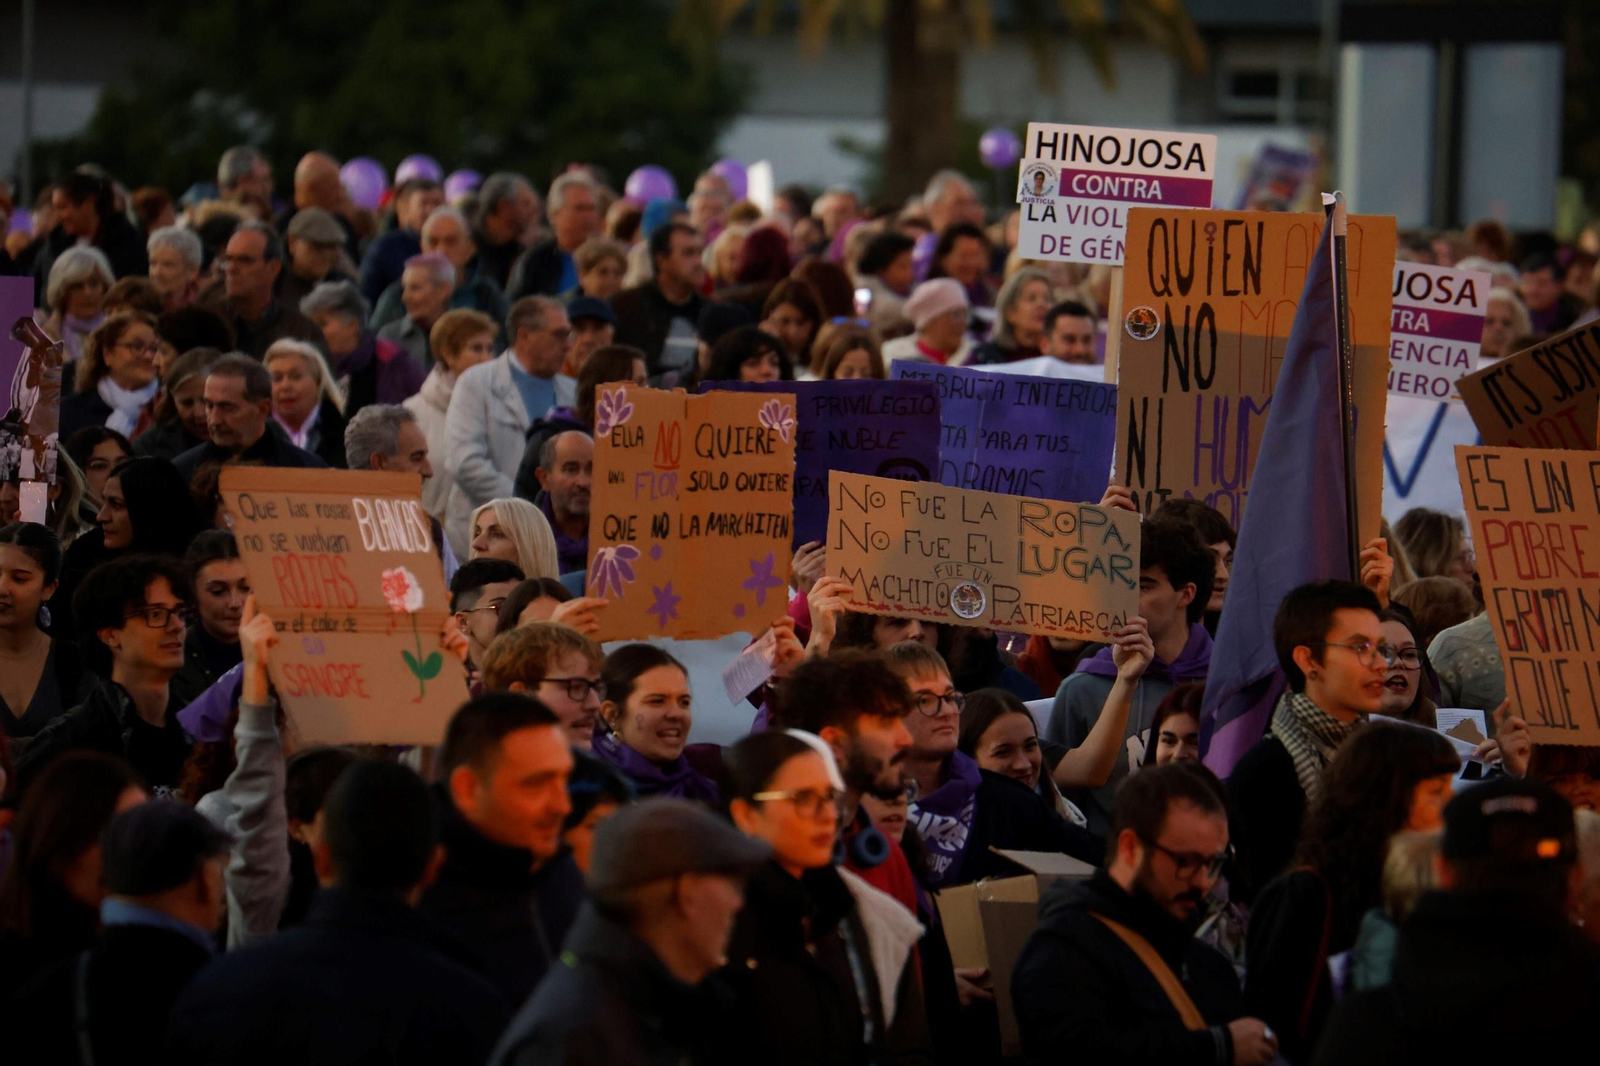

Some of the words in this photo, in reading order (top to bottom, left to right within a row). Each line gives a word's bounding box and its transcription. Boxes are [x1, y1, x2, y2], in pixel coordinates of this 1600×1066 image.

[1036, 130, 1206, 172] HINOJOSA
[1021, 196, 1055, 205] JUSTICIA
[1071, 173, 1163, 201] CONTRA
[1028, 204, 1057, 223] LA
[1066, 204, 1123, 228] VIOL
[1040, 234, 1072, 256] DE
[1081, 235, 1125, 260] GÉN
[1392, 270, 1477, 308] JOSA
[1162, 302, 1218, 393] NO
[1390, 340, 1470, 369] ENCIA
[812, 394, 937, 416] PRIVILEGIO
[611, 424, 644, 448] ELLA
[653, 421, 682, 467] NO
[695, 423, 776, 460] QUIERE
[829, 428, 906, 451] NUBLE
[978, 428, 1028, 451] PARA
[1125, 396, 1164, 489] NI
[608, 469, 625, 485] UNA
[685, 471, 729, 492] SOLO
[735, 472, 789, 492] QUIERE
[1466, 454, 1511, 512] ES
[1524, 458, 1575, 513] UN
[237, 493, 279, 522] Que
[286, 497, 309, 519] las
[315, 503, 353, 520] rosas
[352, 497, 432, 553] BLANCAS
[961, 495, 997, 524] LA
[242, 533, 263, 553] no
[269, 532, 289, 552] se
[295, 526, 351, 553] vuelvan
[603, 514, 637, 541] QUE
[651, 511, 670, 540] NO
[679, 512, 700, 540] LA
[704, 511, 789, 540] MARCHITEN
[967, 533, 1004, 565] EL
[1481, 518, 1599, 581] POBRE
[272, 551, 359, 609] ROJAS
[840, 566, 949, 608] MACHITO
[934, 564, 963, 579] FUE
[972, 567, 993, 585] UN
[274, 620, 287, 632] or
[292, 613, 305, 633] el
[311, 614, 338, 633] color
[344, 614, 358, 633] de
[281, 662, 370, 699] SANGRE
[1509, 656, 1580, 730] QUE
